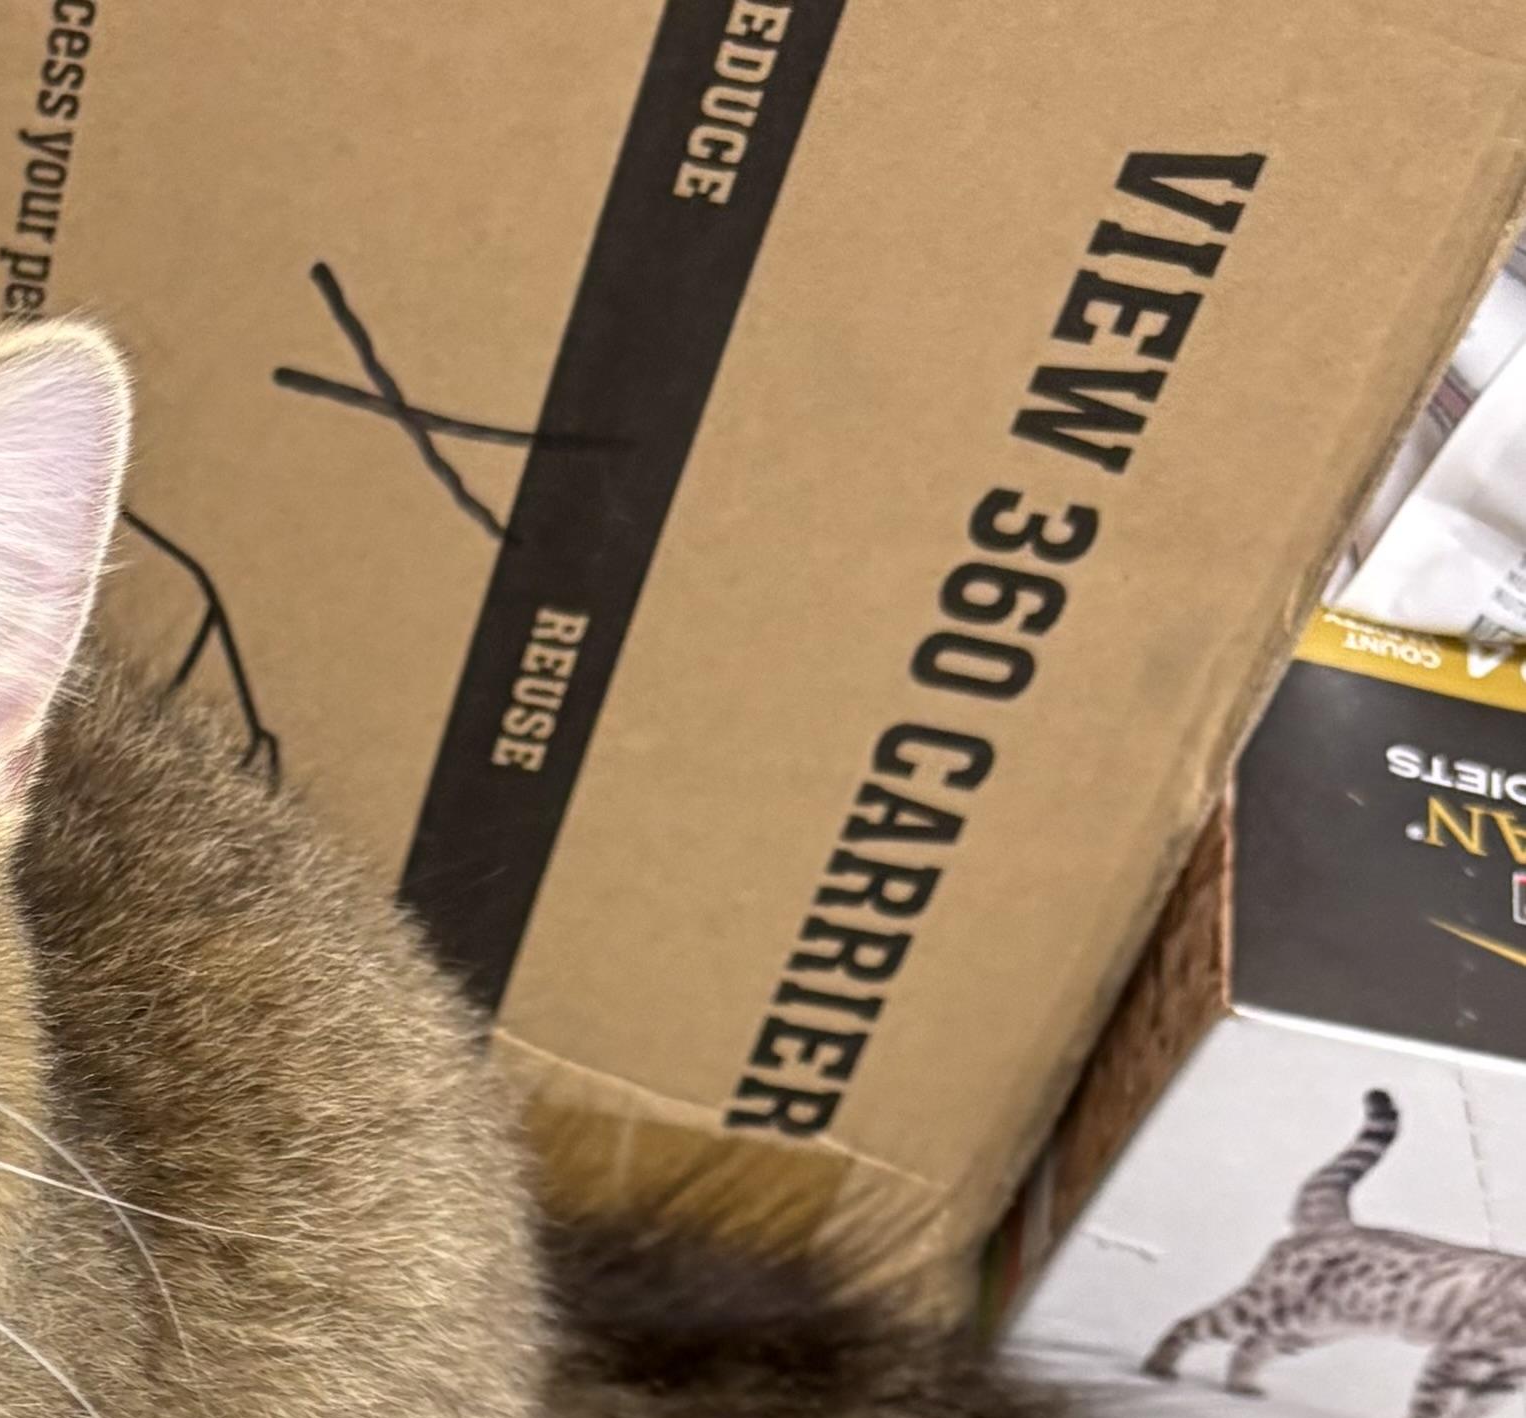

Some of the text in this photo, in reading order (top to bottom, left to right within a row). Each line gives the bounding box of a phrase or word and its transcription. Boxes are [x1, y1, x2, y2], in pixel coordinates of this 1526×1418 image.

[36, 0, 97, 121] cess
[674, 0, 787, 204] EDUCE
[15, 128, 74, 244] your
[492, 608, 589, 771] REUSE
[724, 151, 1267, 1139] VIEW 360 CARRIER
[1342, 631, 1441, 669] COUNT
